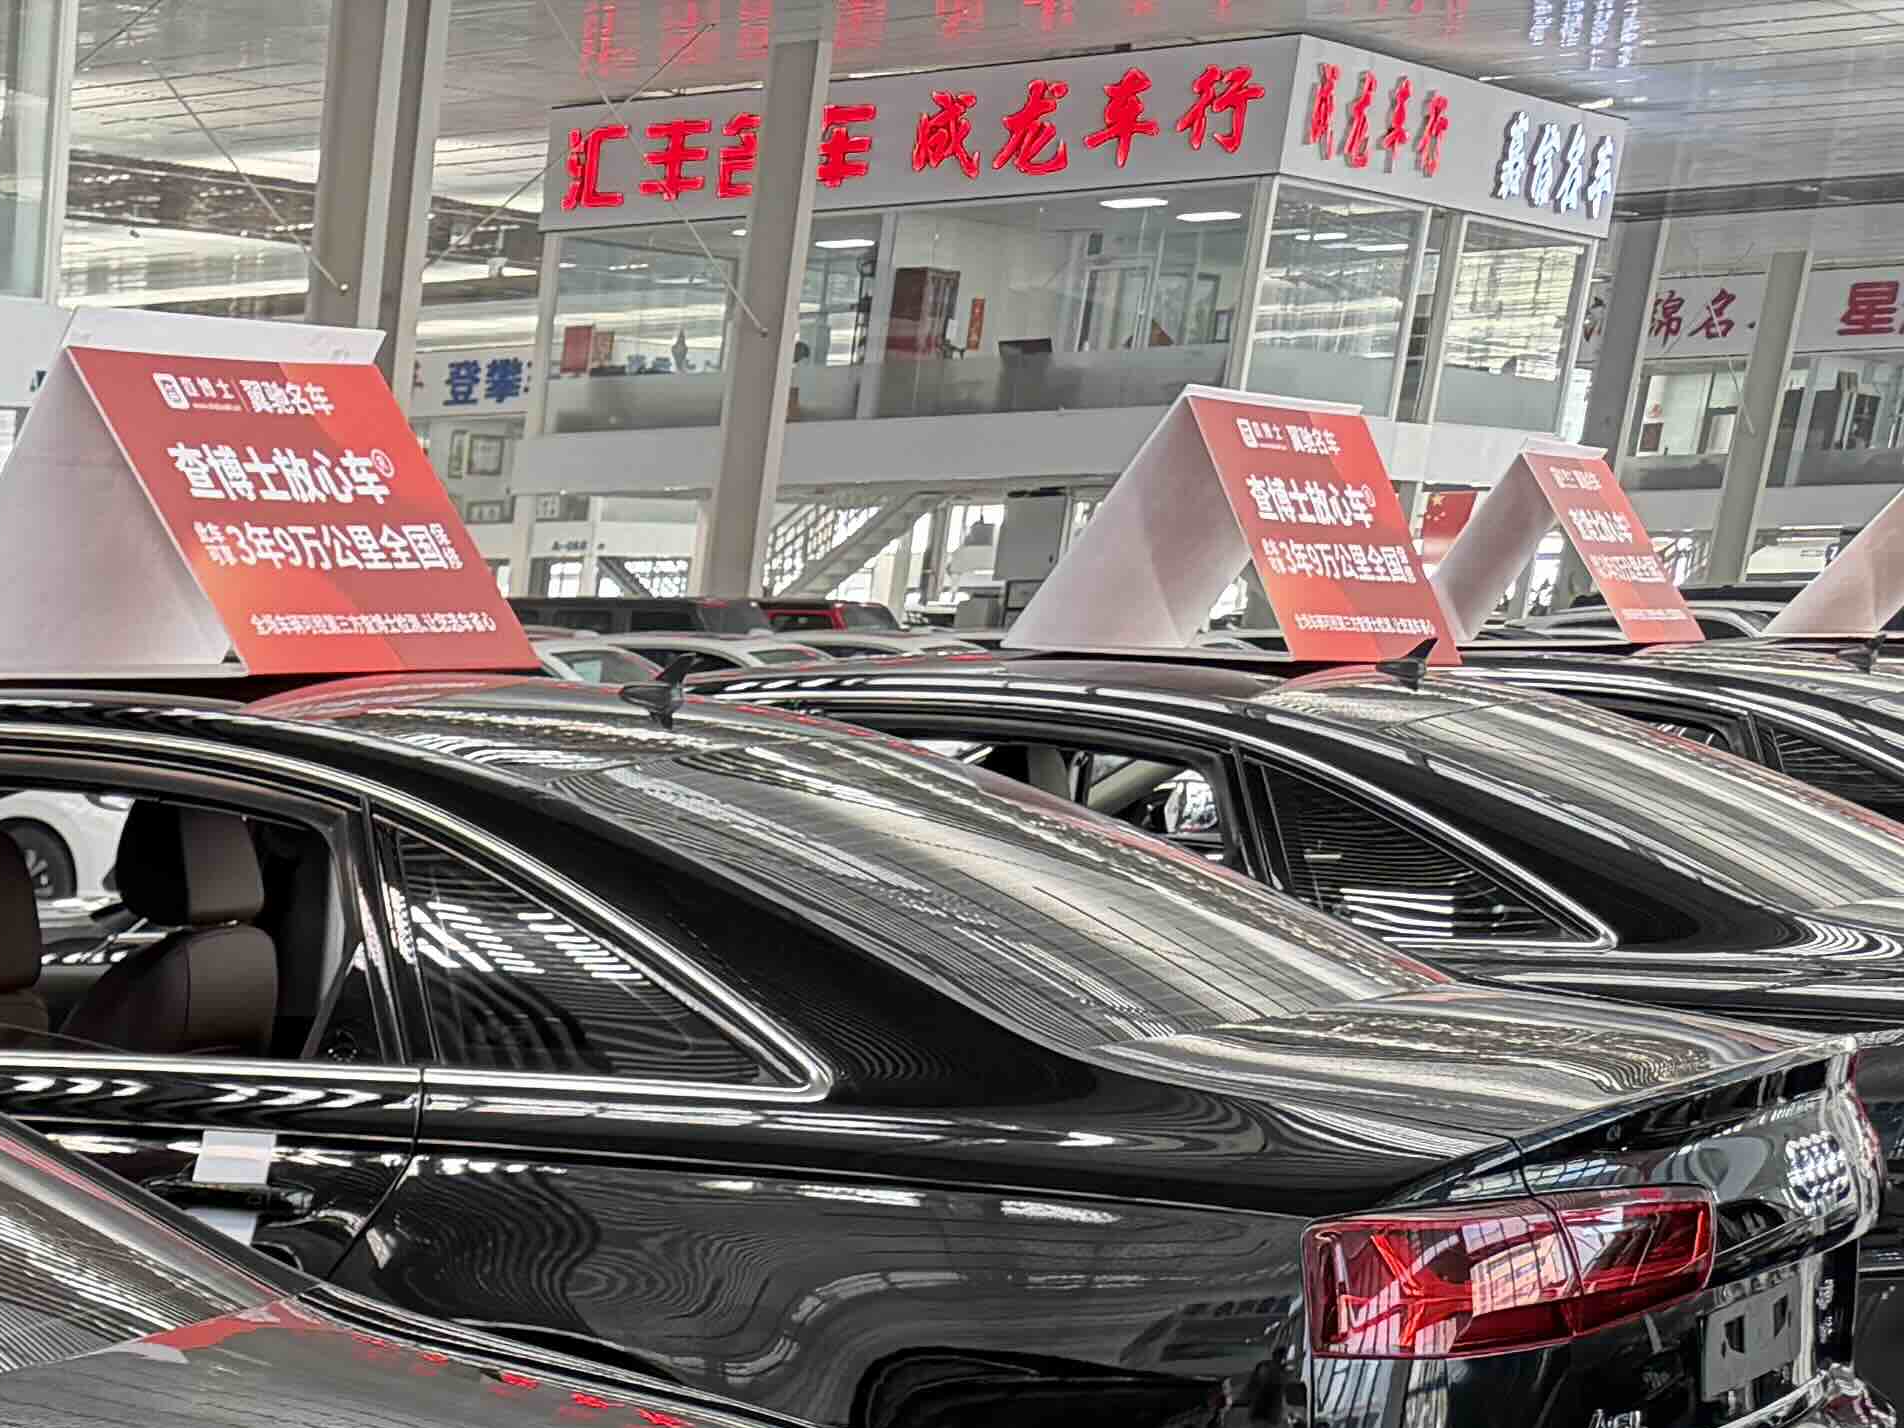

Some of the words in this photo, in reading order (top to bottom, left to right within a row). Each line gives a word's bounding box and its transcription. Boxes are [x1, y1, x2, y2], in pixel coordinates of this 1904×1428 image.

[1837, 280, 1904, 337] 星
[442, 356, 534, 407] 登攀
[166, 441, 391, 505] 查博士放心车
